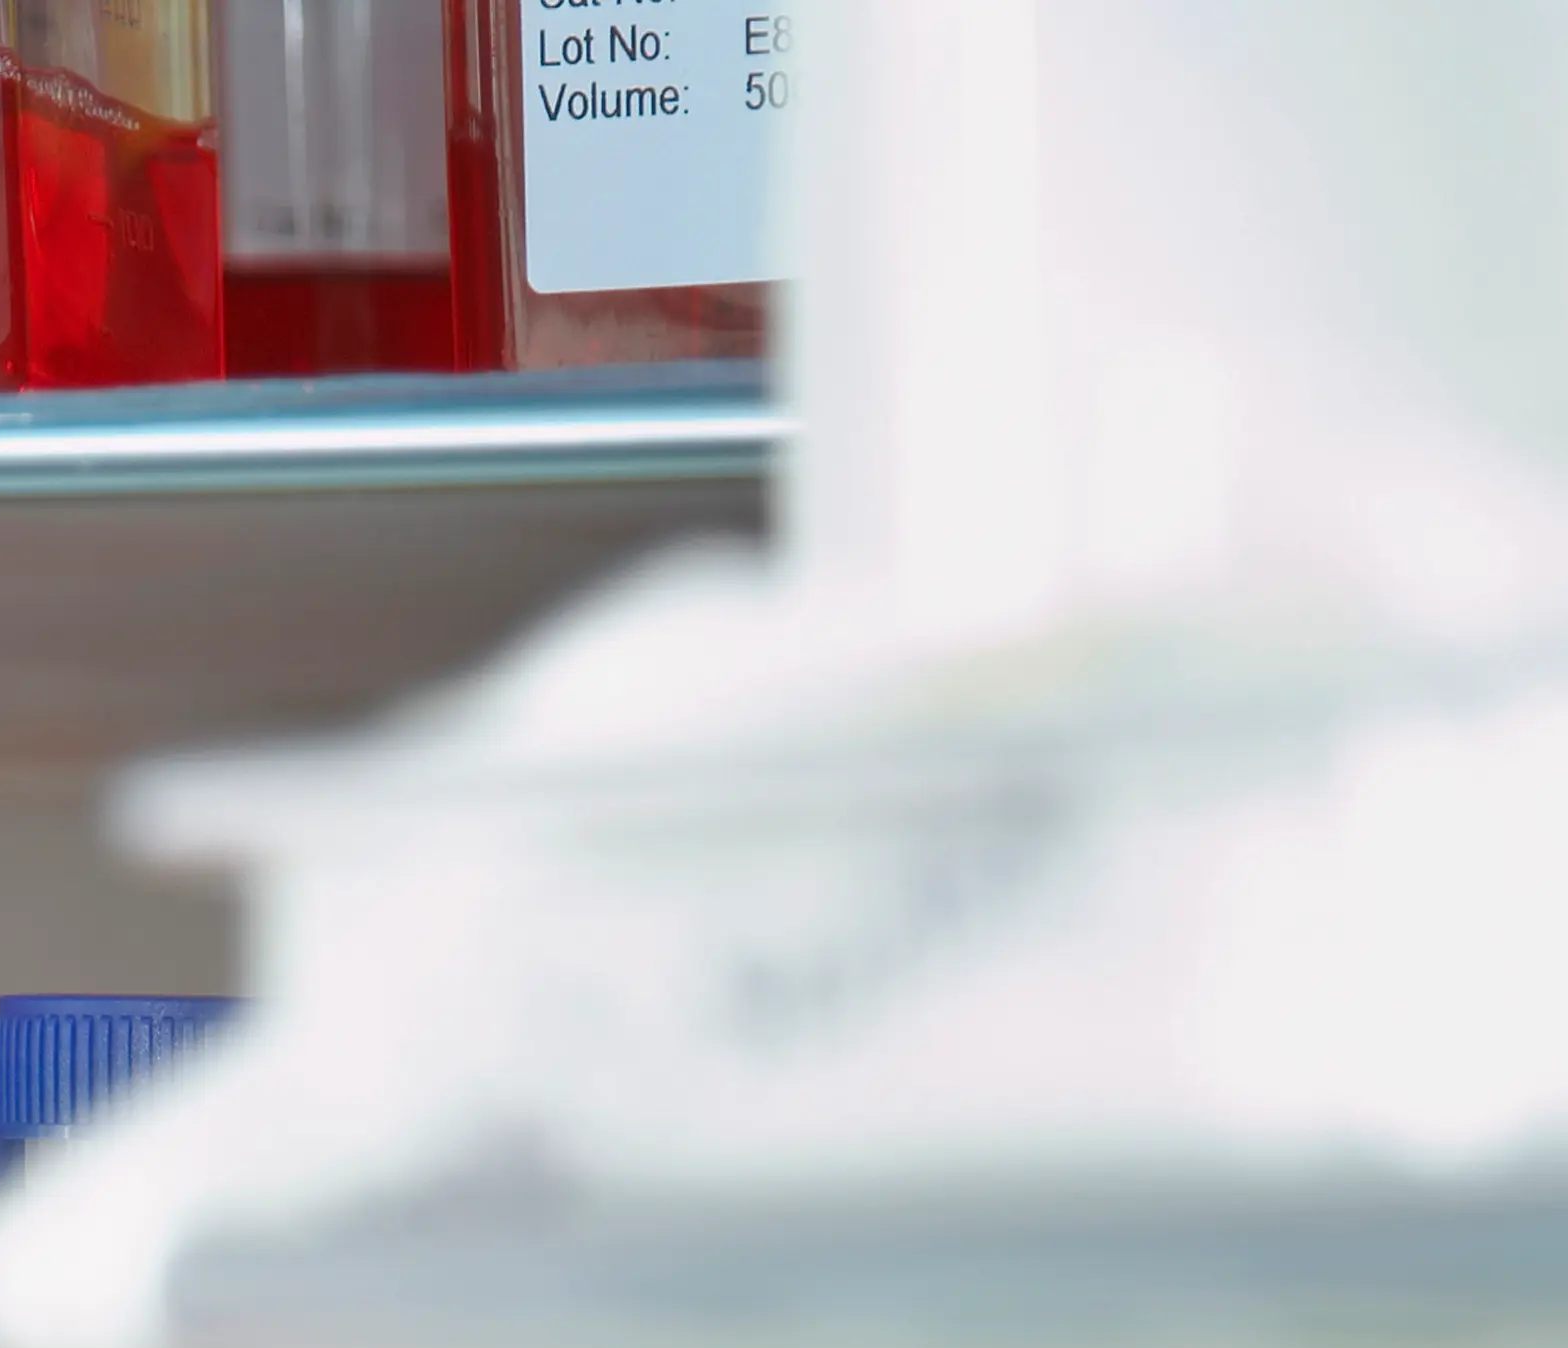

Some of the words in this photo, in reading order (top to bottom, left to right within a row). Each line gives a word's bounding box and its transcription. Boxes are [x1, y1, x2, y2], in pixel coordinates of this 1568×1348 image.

[539, 28, 596, 67] Lot
[609, 24, 670, 62] No:
[538, 81, 690, 122] Volume:
[745, 70, 806, 111] 50
